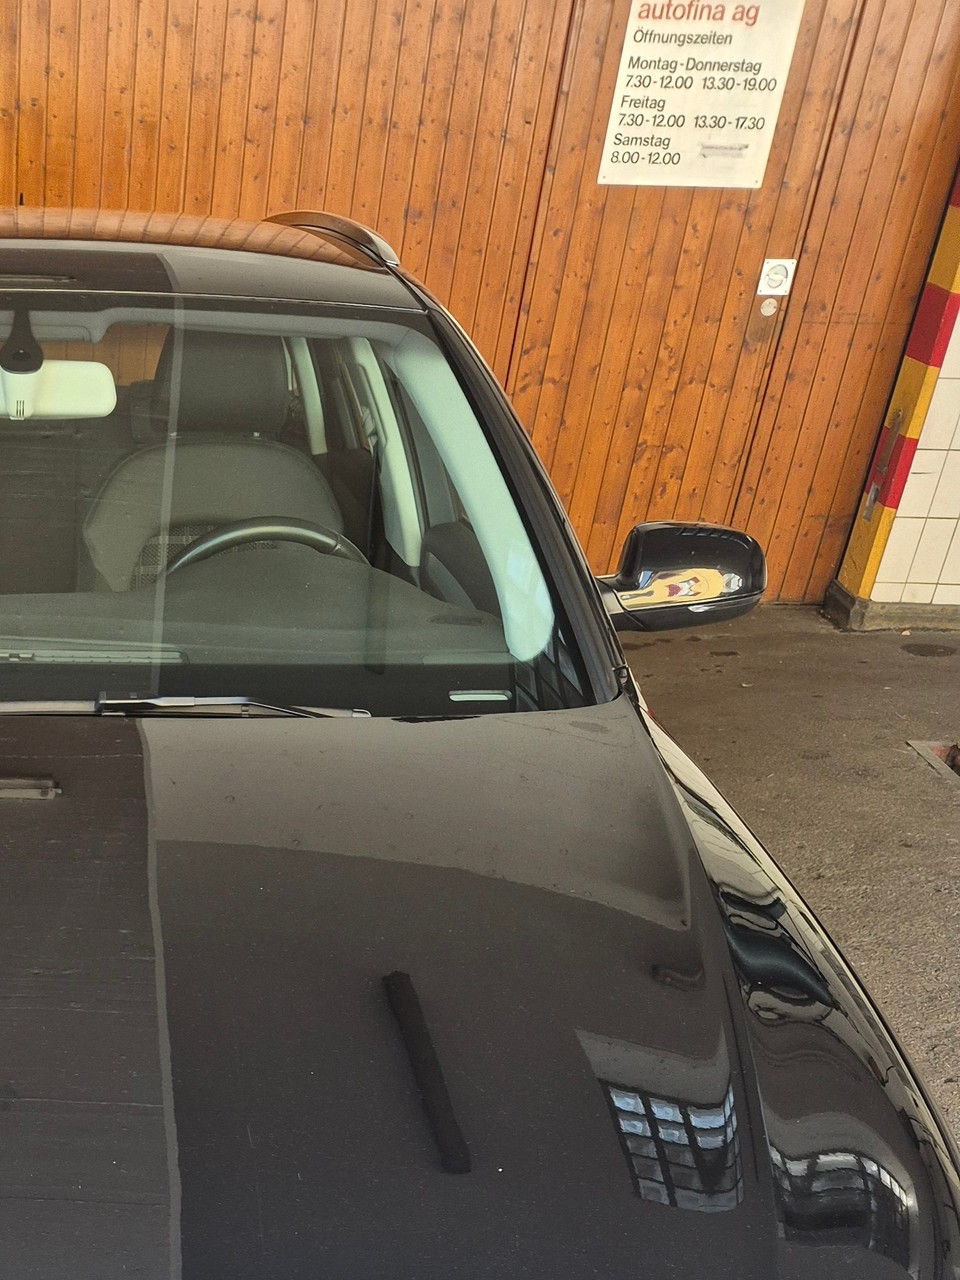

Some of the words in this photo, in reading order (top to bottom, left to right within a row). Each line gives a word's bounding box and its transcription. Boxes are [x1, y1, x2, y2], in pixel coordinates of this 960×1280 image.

[637, 0, 726, 21] autofina
[731, 4, 761, 26] ag
[633, 26, 733, 46] Öffnungszeiten
[620, 94, 666, 111] Freitag
[613, 132, 671, 150] Samstag
